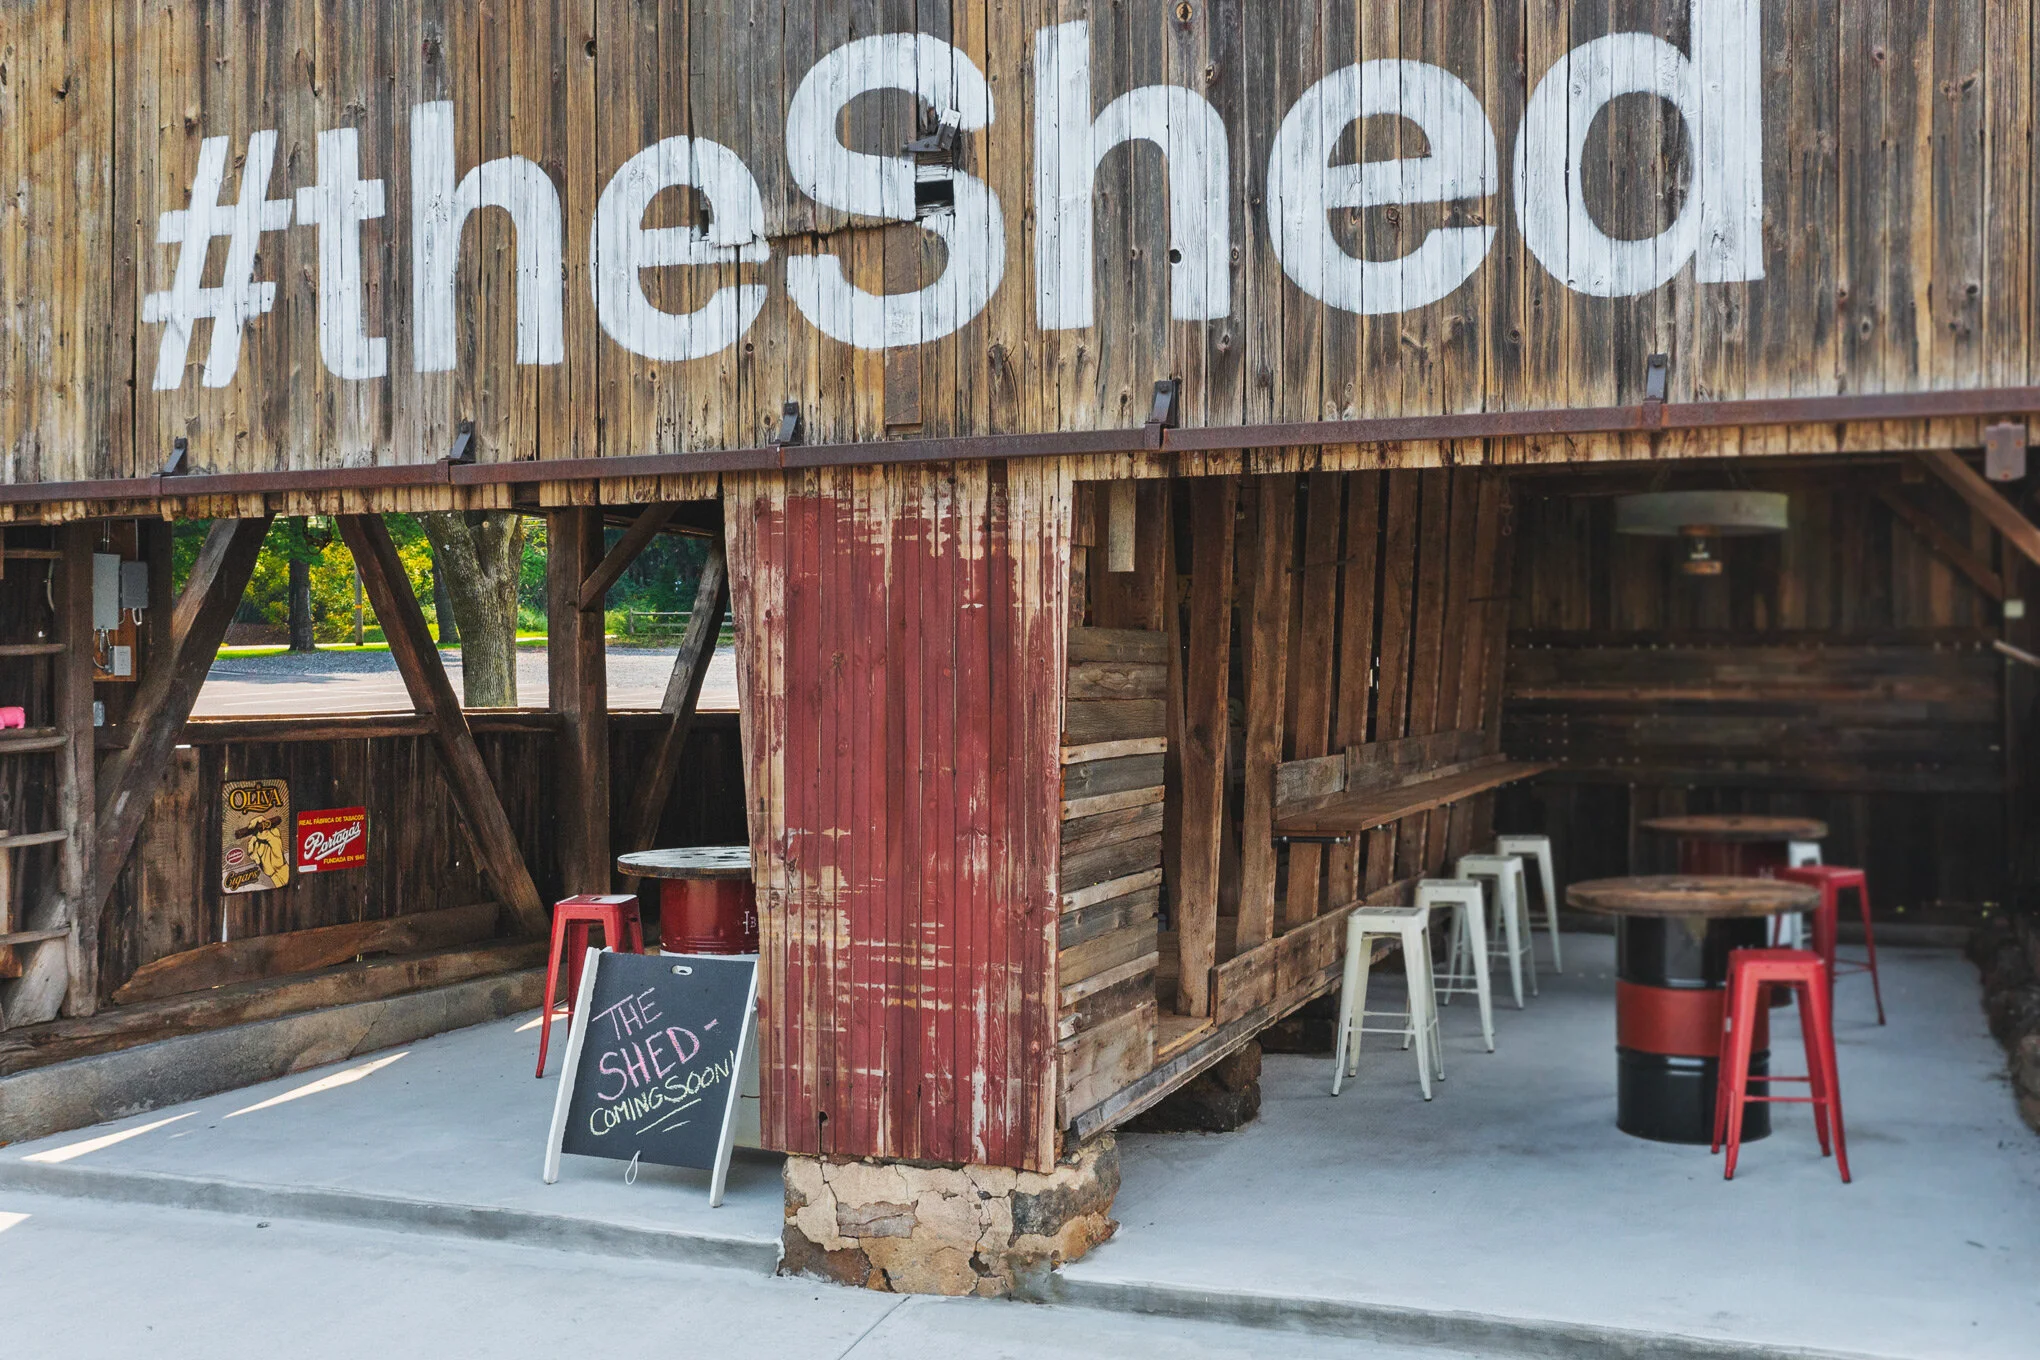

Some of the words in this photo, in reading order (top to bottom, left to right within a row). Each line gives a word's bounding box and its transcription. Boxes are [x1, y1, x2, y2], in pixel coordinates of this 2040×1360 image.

[142, 0, 1765, 390] #theShed
[229, 789, 282, 811] OLIVA
[224, 868, 260, 891] Cigars
[592, 987, 663, 1040] THE
[589, 1085, 665, 1136] COMING
